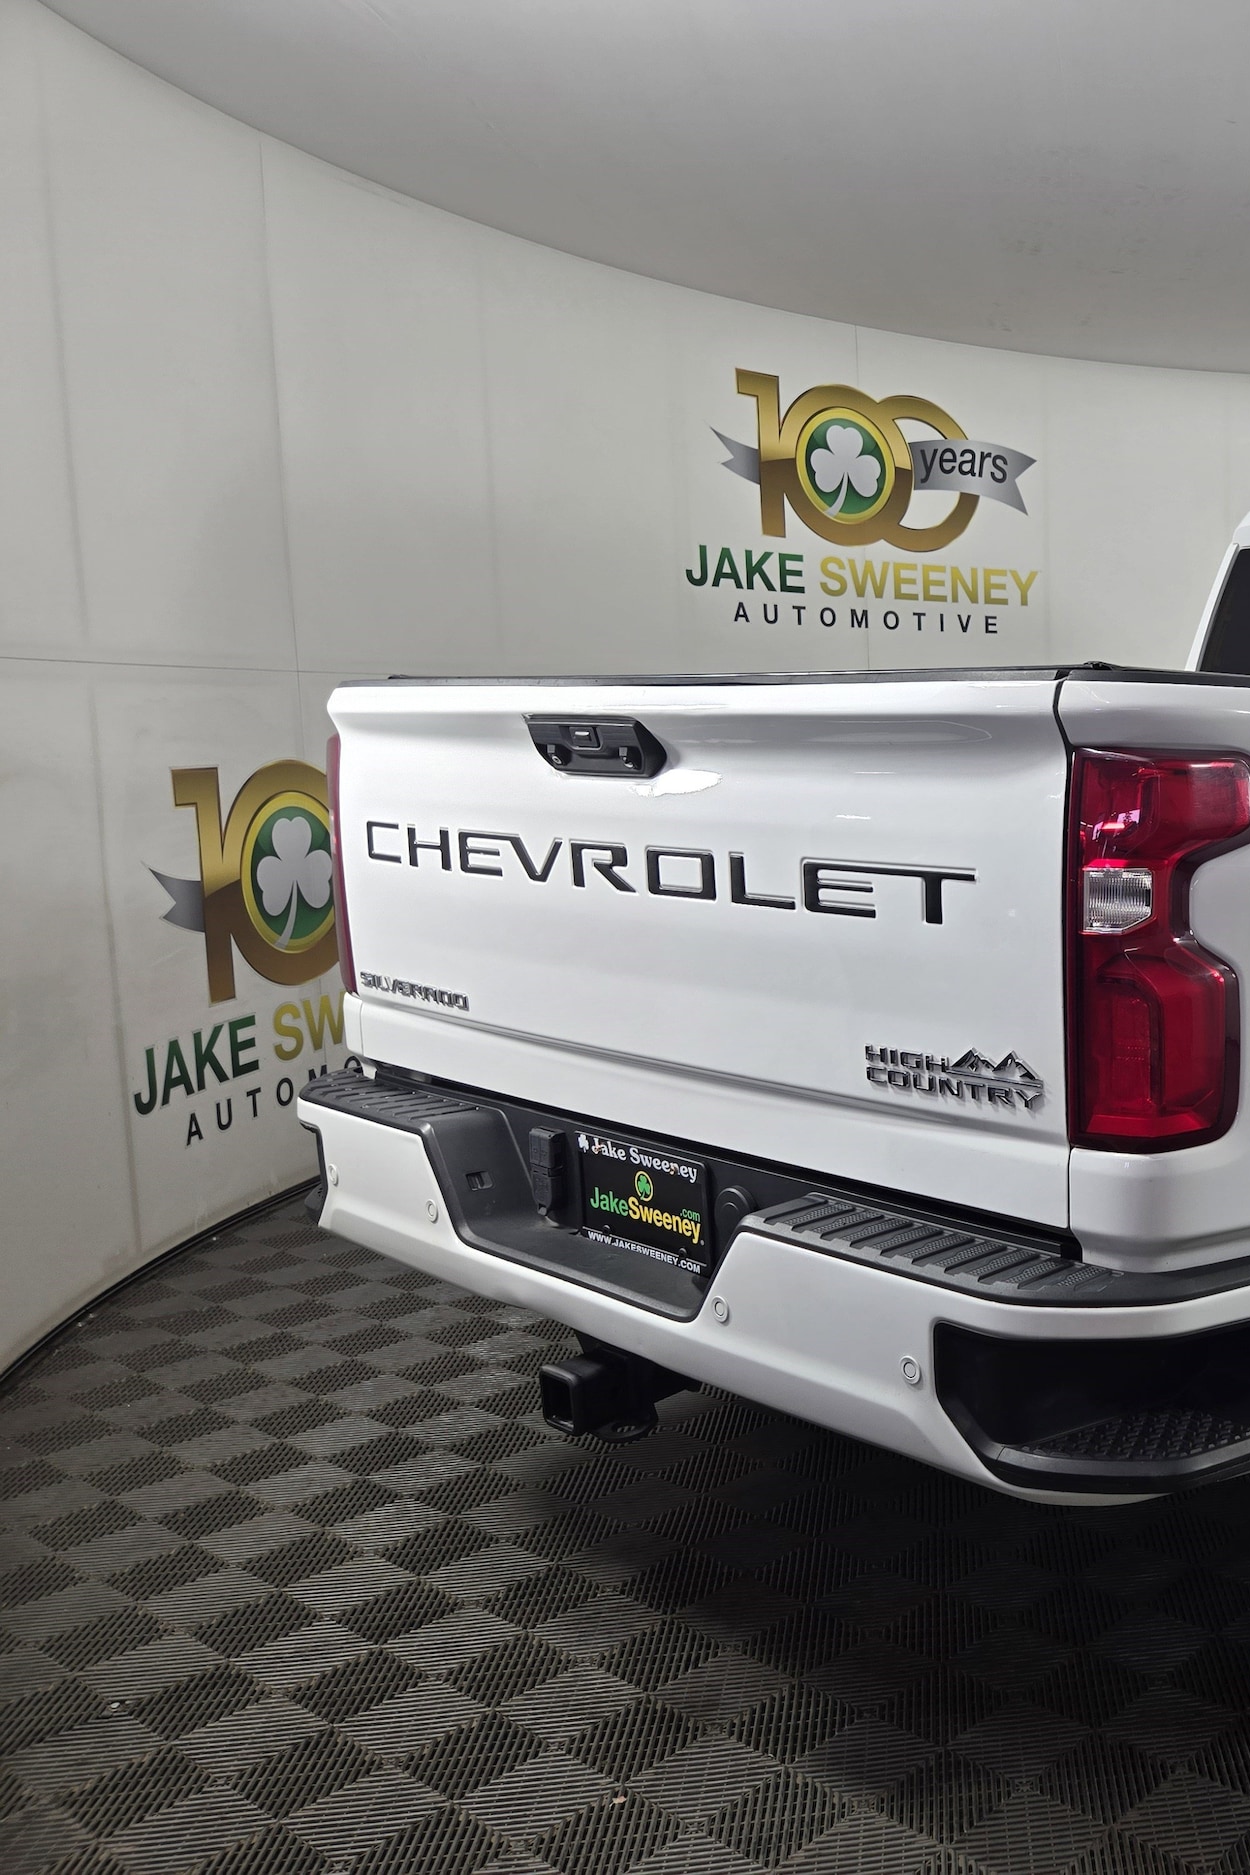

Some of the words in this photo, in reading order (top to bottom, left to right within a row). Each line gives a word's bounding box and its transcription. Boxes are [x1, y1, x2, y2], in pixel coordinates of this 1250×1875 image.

[920, 446, 1009, 483] years
[686, 544, 805, 593] JAKE
[819, 556, 1038, 606] SWEENEY
[733, 601, 998, 634] AUTOMOTIVE
[366, 819, 978, 926] CHEVROLET
[360, 971, 469, 1011] SILVERADO
[134, 1014, 260, 1115] JAKE
[865, 1043, 950, 1073] HIGH
[866, 1065, 1042, 1109] COUNTRY
[592, 1136, 626, 1161] Jake
[629, 1147, 698, 1184] Sweeney
[587, 1230, 701, 1274] WWW.JAKESWEENEY.COM
